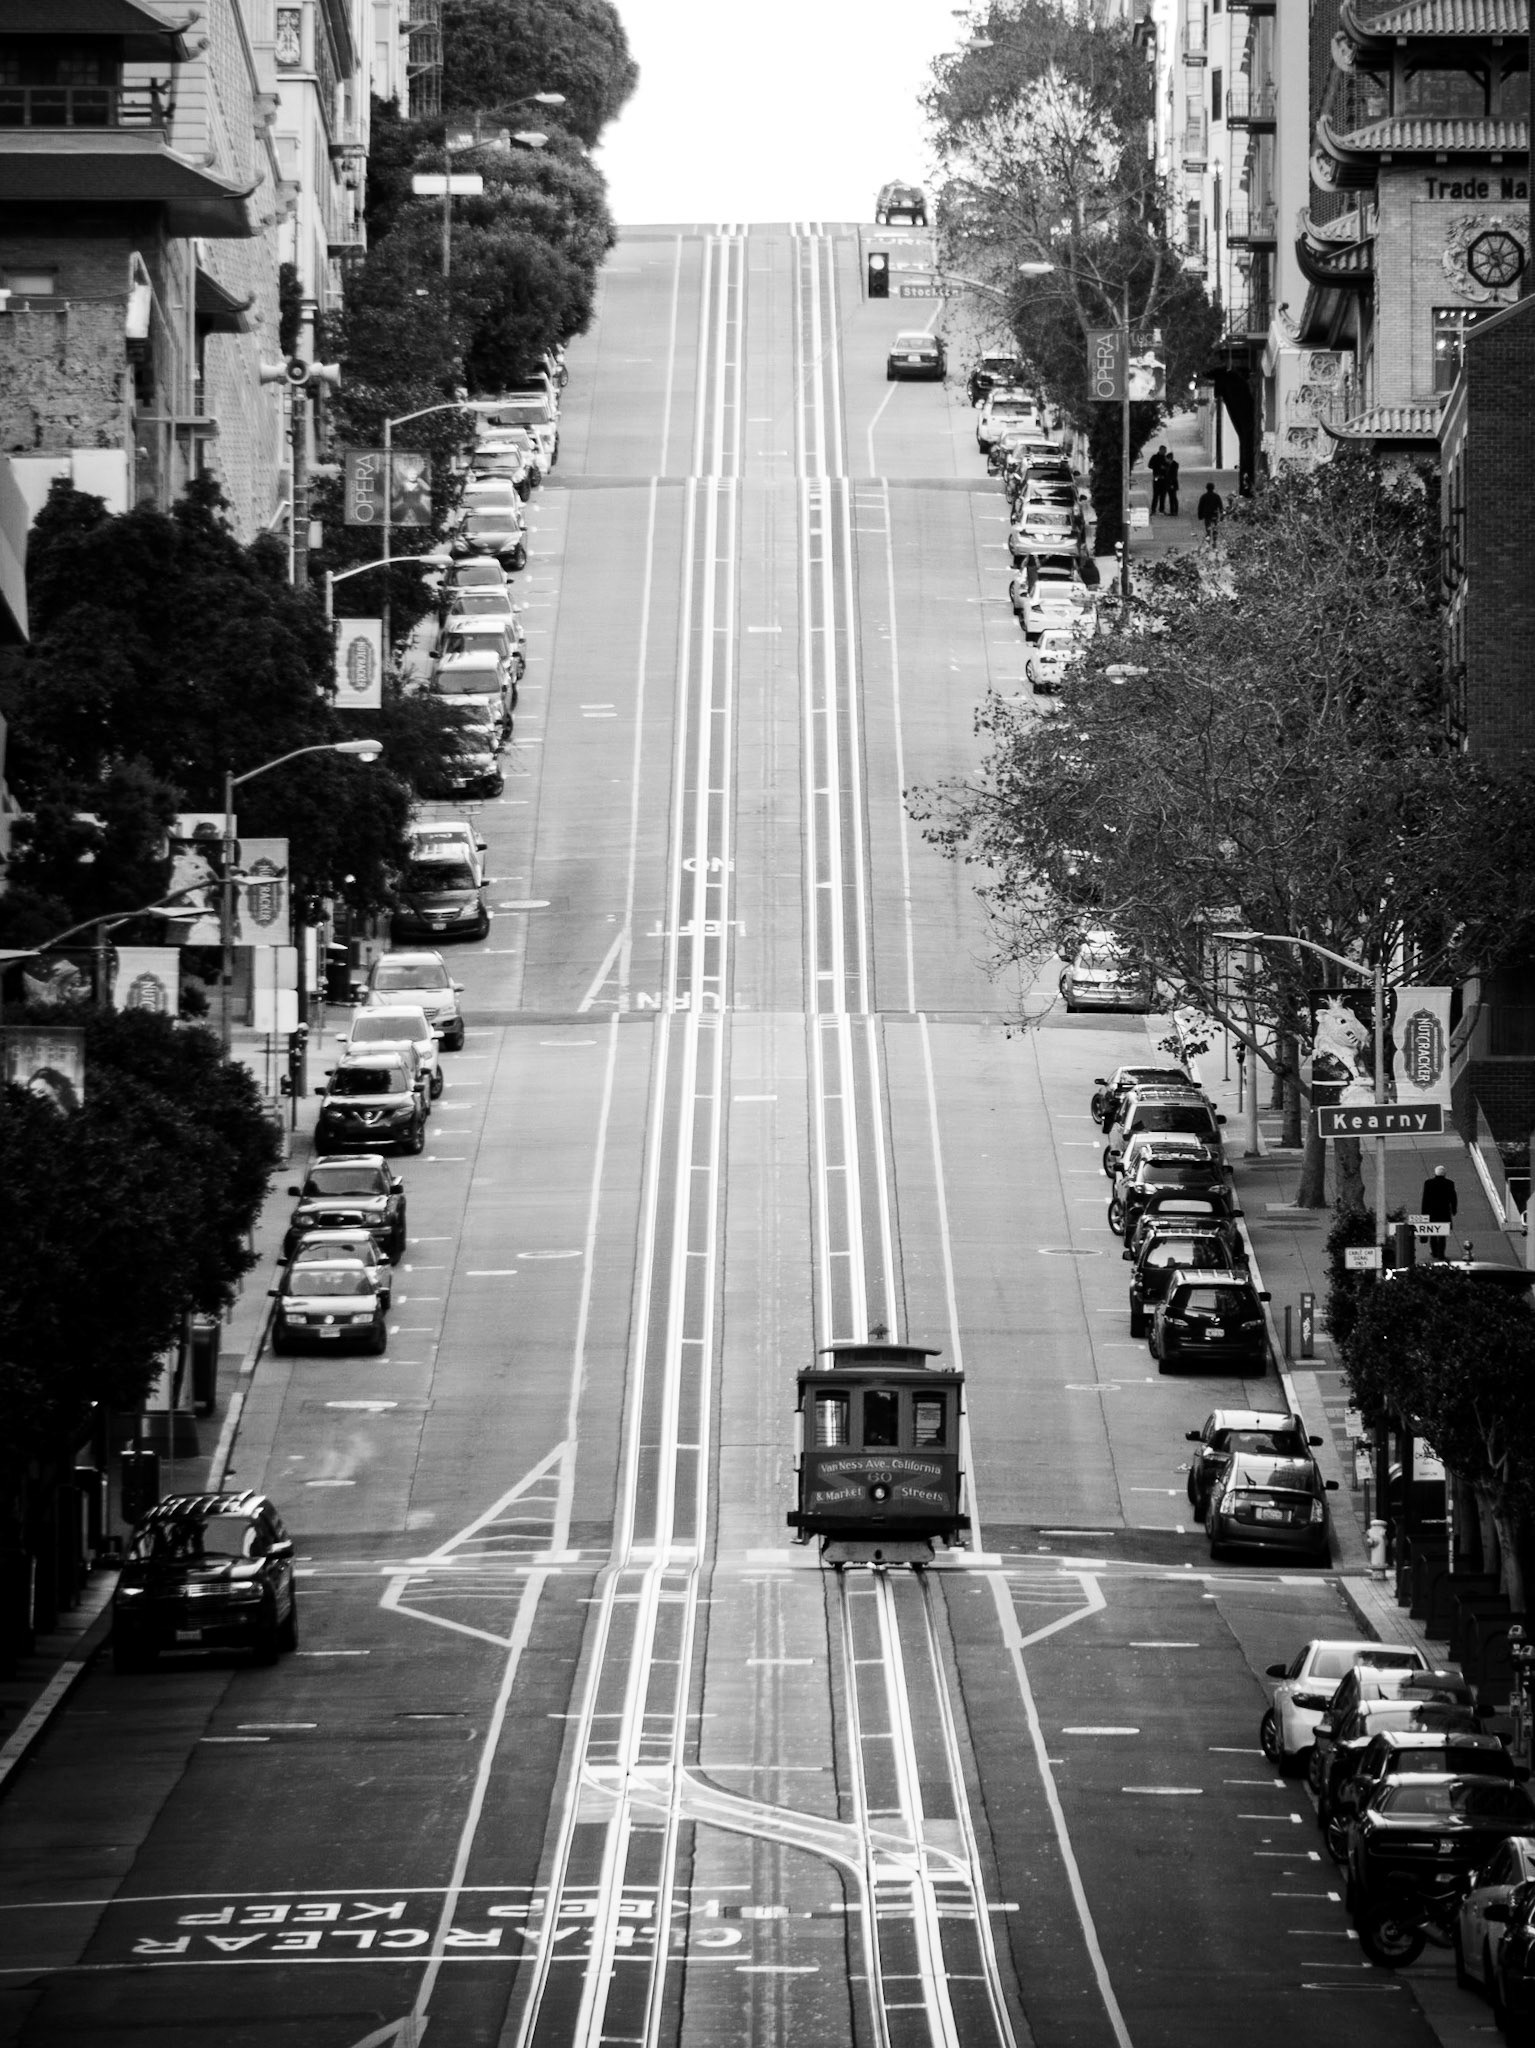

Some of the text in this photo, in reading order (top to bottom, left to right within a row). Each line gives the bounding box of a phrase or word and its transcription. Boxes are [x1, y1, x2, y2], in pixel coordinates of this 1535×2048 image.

[1424, 177, 1489, 199] Trade
[1097, 334, 1115, 397] OPERA
[355, 453, 375, 522] OPERA
[259, 865, 272, 920] NURACKER
[1415, 1017, 1433, 1081] NUTCRACKER
[1333, 1113, 1428, 1130] Kearny
[1414, 1225, 1442, 1233] ARNY
[867, 1472, 893, 1483] 60
[891, 1459, 942, 1475] California
[825, 1487, 862, 1500] Market
[901, 1487, 943, 1502] Streets
[176, 1901, 408, 1925] KEEP
[132, 1927, 430, 1953] CLEAR
